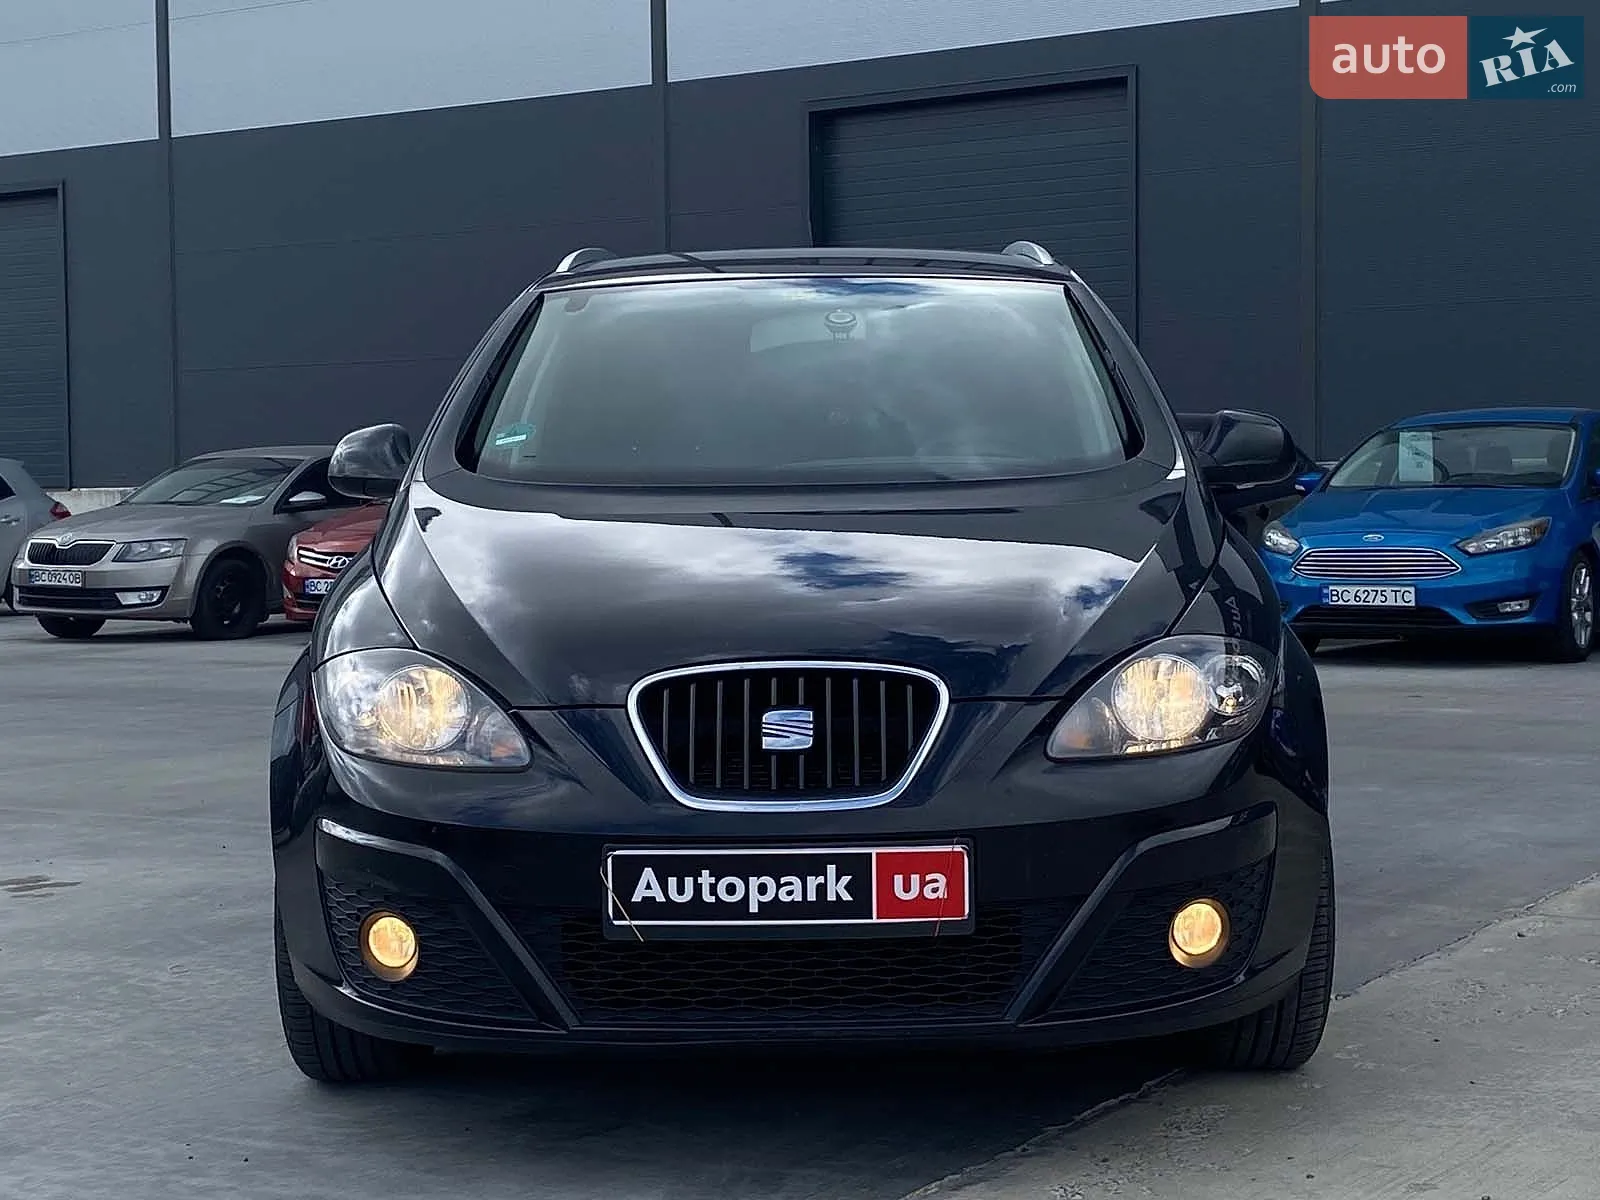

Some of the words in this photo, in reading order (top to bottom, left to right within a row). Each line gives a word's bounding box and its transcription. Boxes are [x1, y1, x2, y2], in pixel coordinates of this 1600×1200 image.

[34, 571, 46, 582] BC
[309, 580, 321, 592] BC
[1330, 588, 1351, 603] BC
[1353, 588, 1388, 603] 6275
[1391, 589, 1412, 604] TC
[630, 864, 853, 913] Autopark
[893, 872, 948, 901] ua
